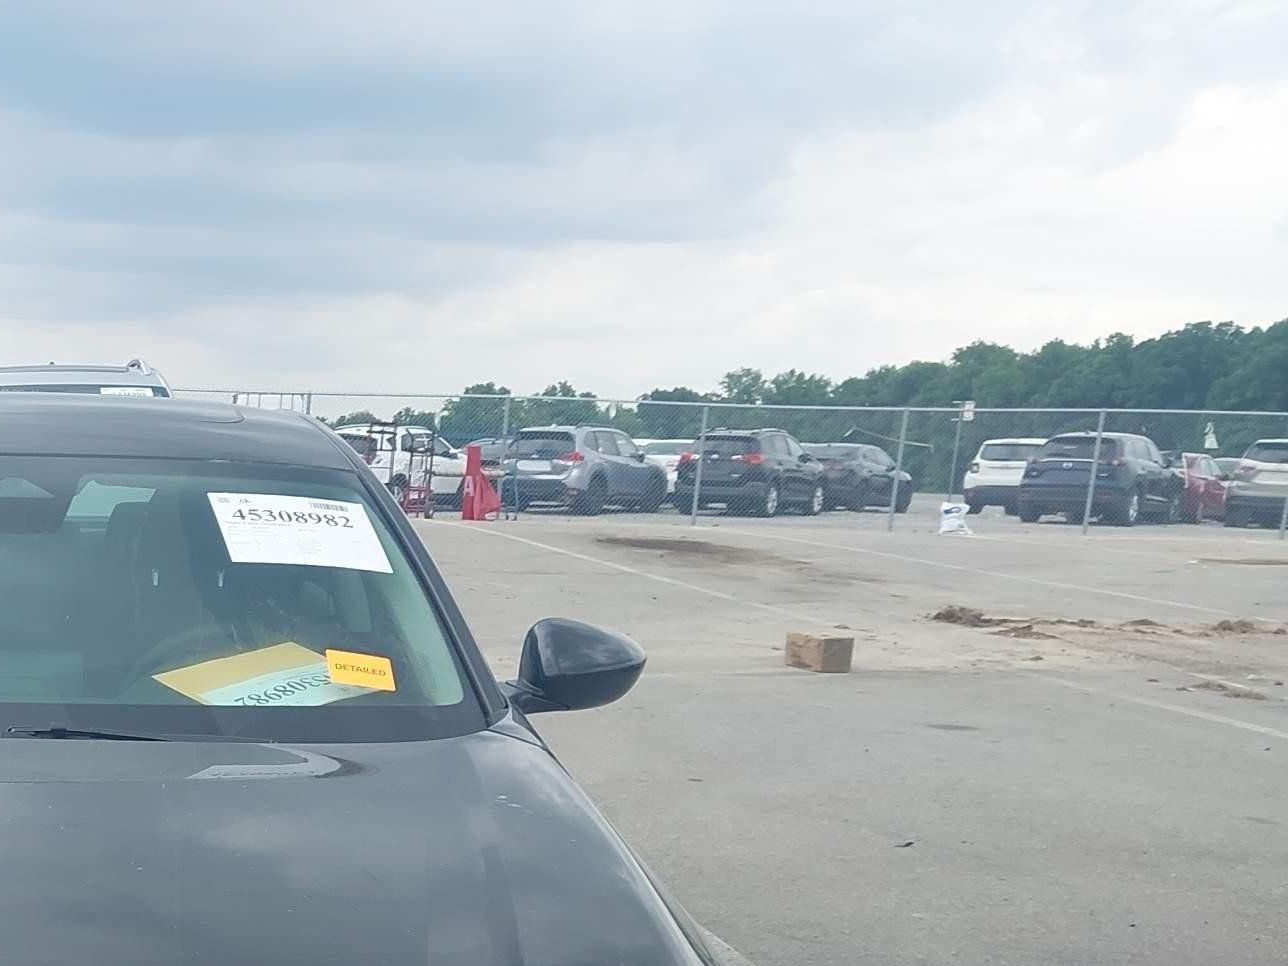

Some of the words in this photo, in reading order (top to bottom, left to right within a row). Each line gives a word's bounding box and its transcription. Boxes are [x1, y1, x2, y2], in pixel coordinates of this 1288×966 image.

[231, 508, 354, 528] 45308982
[334, 662, 387, 677] DETAILED
[235, 674, 330, 706] 5308982
